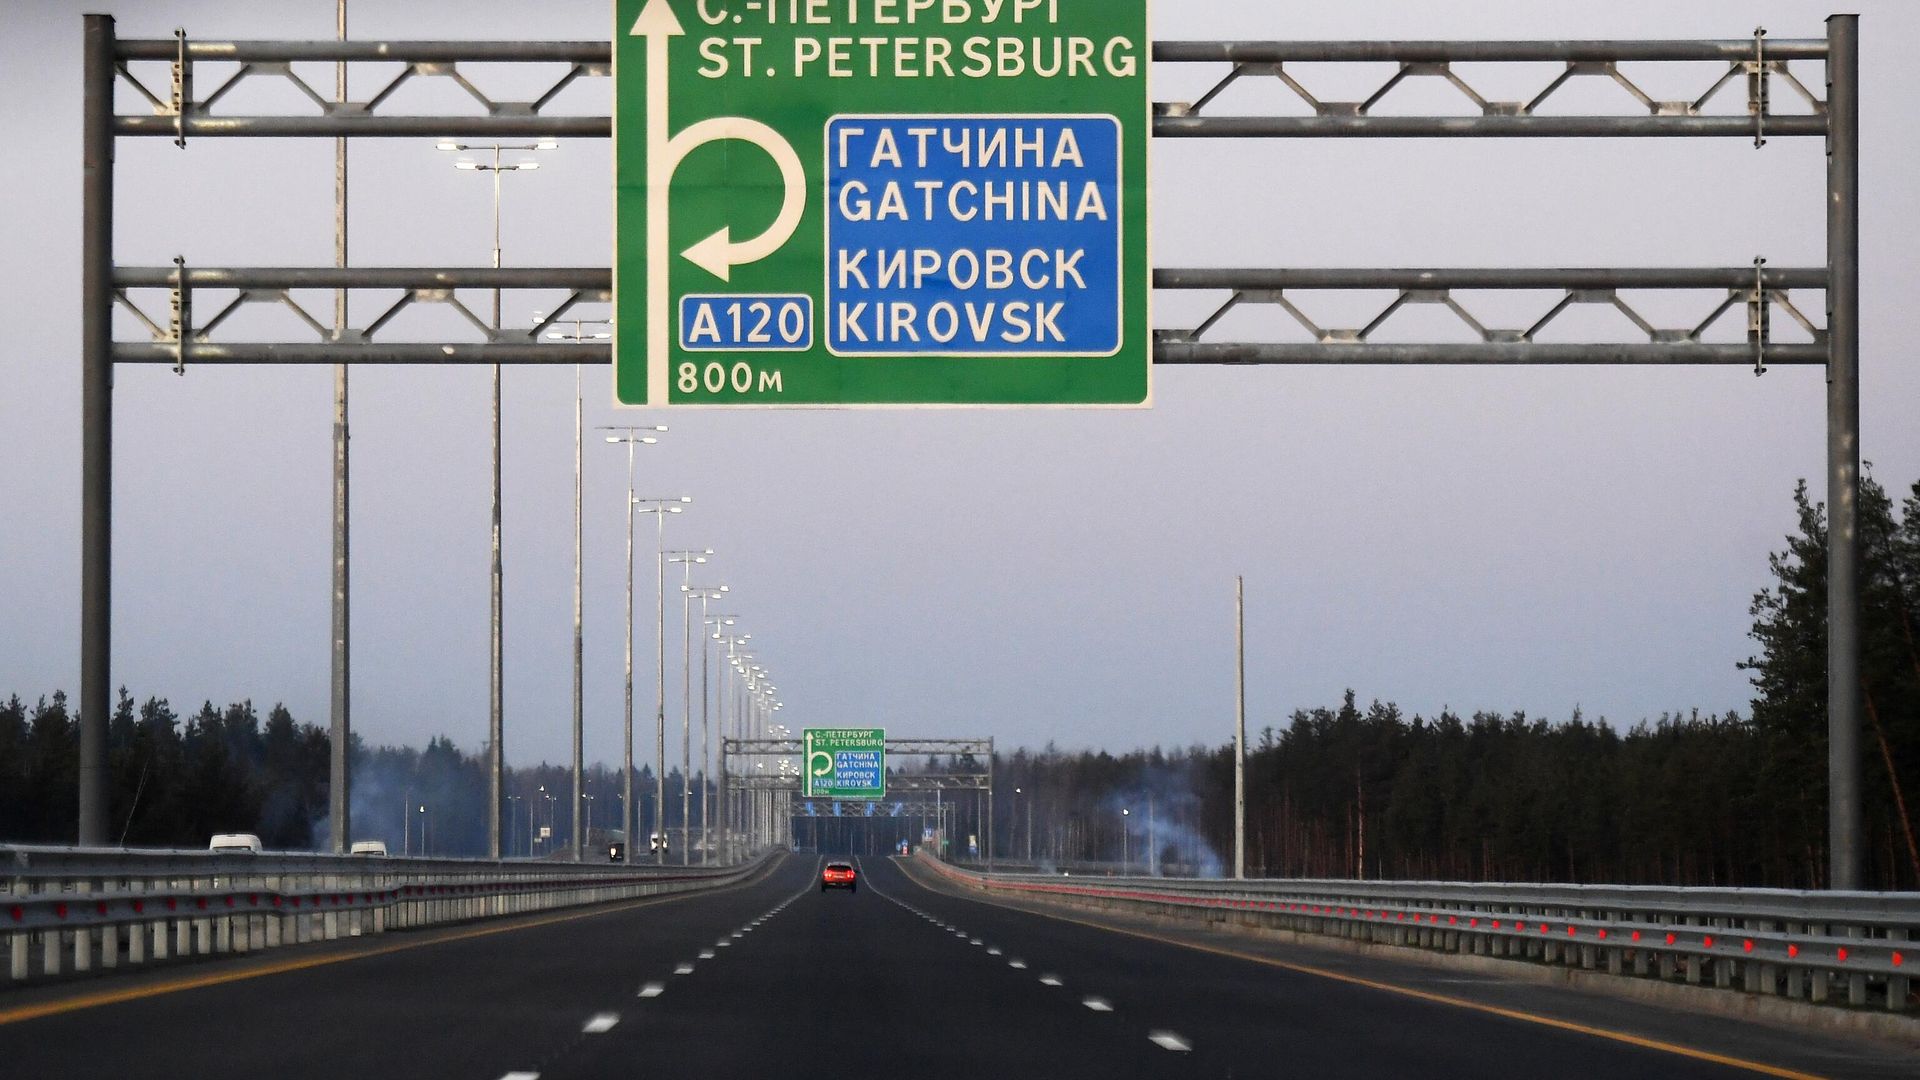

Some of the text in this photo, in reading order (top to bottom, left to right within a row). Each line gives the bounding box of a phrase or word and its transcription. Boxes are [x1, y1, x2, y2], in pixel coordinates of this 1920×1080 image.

[697, 36, 1137, 78] ST. PETERSBURG
[838, 128, 1084, 168] ГАТЧИНА
[838, 181, 1108, 222] GATCHINA
[838, 249, 1087, 290] КИРОВСК
[838, 302, 1066, 343] KIROVSK
